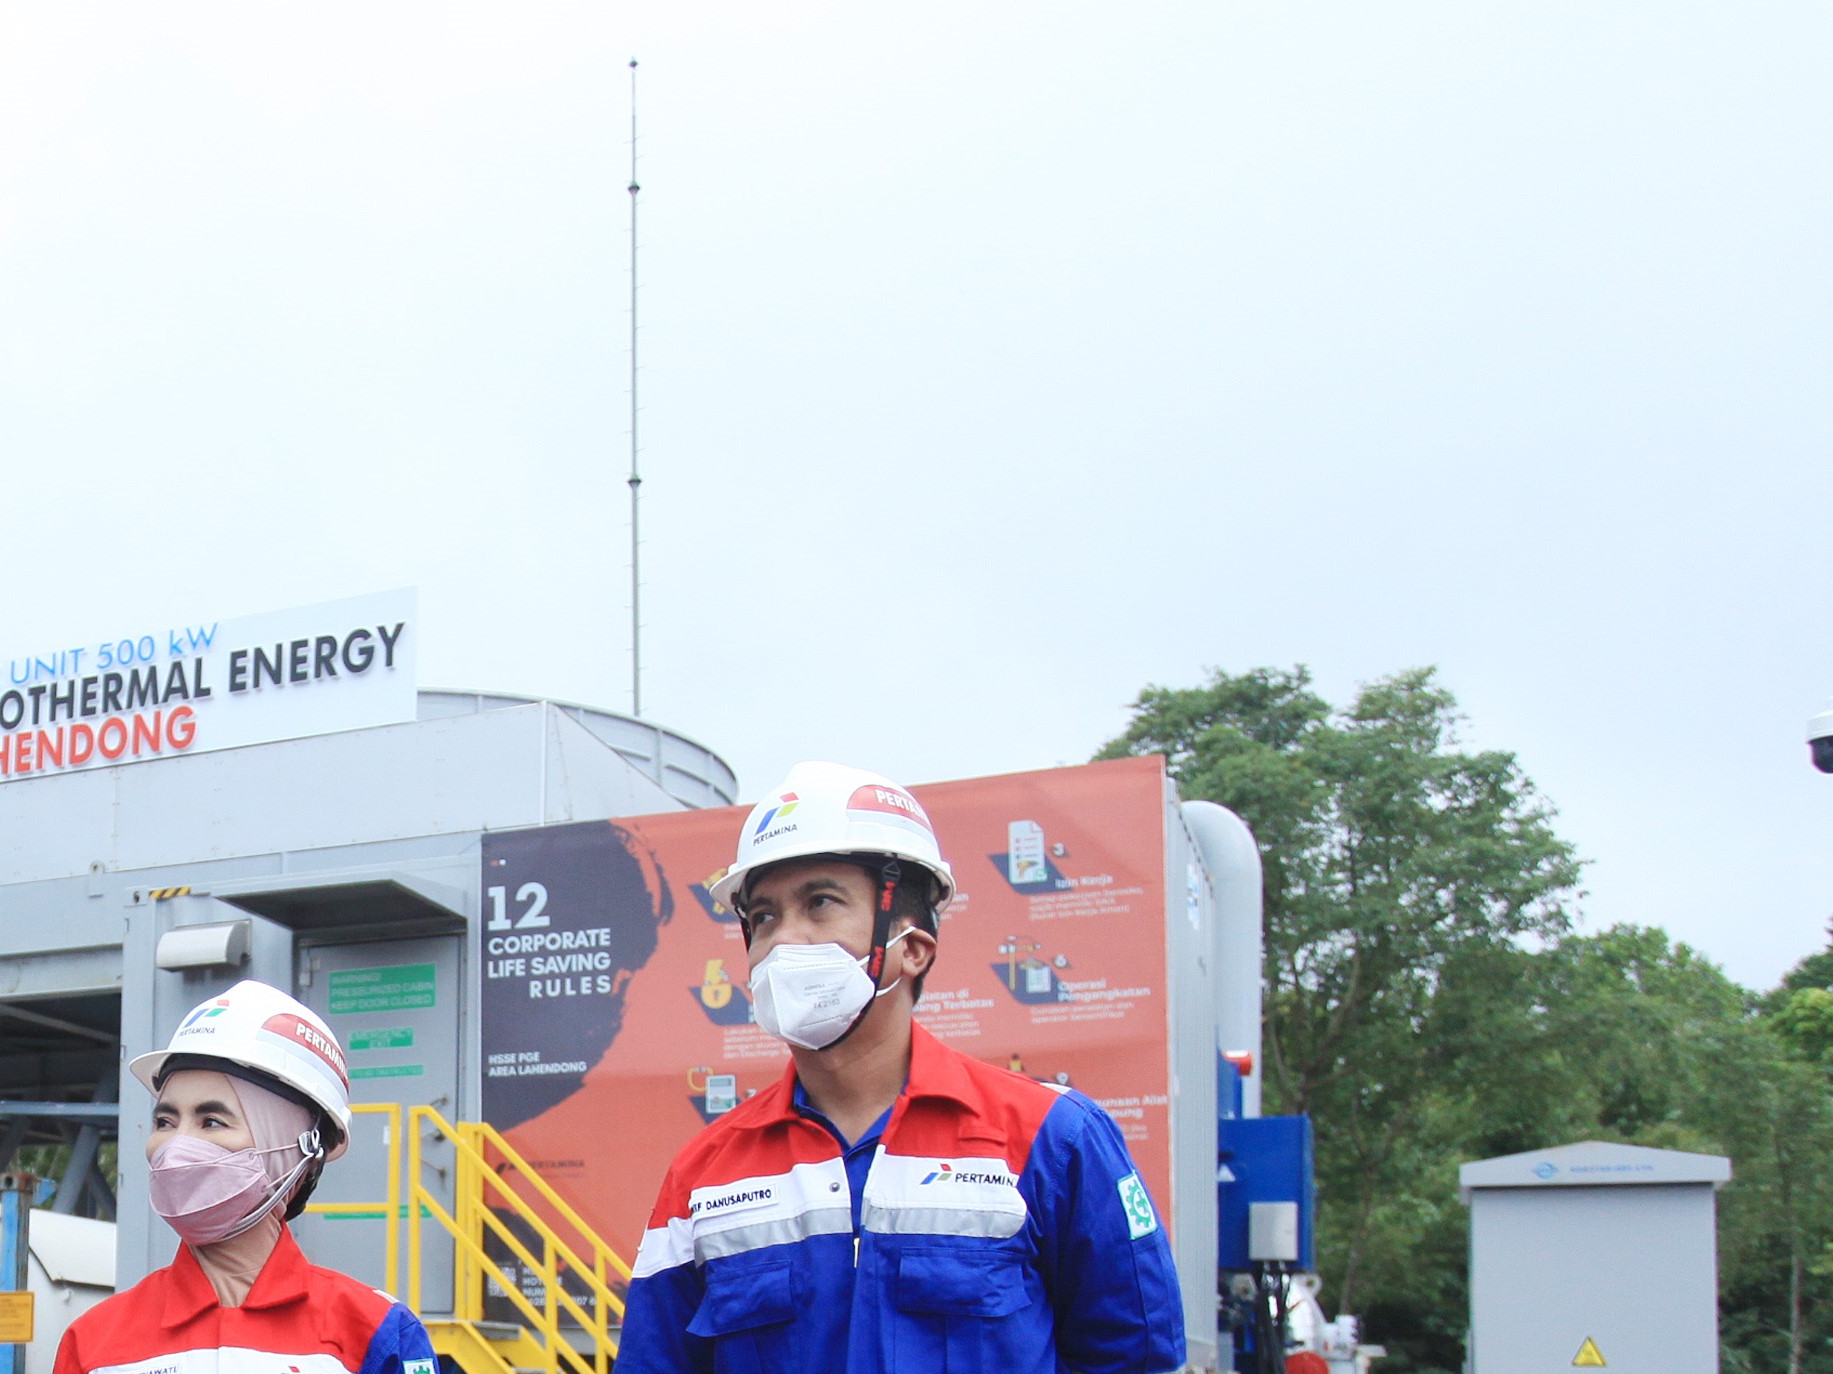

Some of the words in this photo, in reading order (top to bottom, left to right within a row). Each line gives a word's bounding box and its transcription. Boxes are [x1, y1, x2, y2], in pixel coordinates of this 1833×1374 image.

[10, 647, 85, 684] UNIT
[97, 635, 155, 669] 500
[169, 622, 219, 656] kW
[228, 621, 406, 693] ENERGY
[753, 823, 798, 847] PERTAMINA
[487, 881, 551, 931] 12
[488, 928, 611, 955] CORPORATE
[487, 958, 526, 979] LIFE
[530, 952, 611, 976] SAVING
[529, 975, 611, 999] RULES
[294, 1022, 347, 1080] PERTAMIN
[488, 1053, 516, 1066] HSSE
[518, 1051, 540, 1064] PGE
[488, 1065, 517, 1078] AREA
[518, 1061, 587, 1076] LAHENDONG
[955, 1172, 1016, 1188] PERTAMIN
[706, 1188, 772, 1211] DANUSAPUTRO
